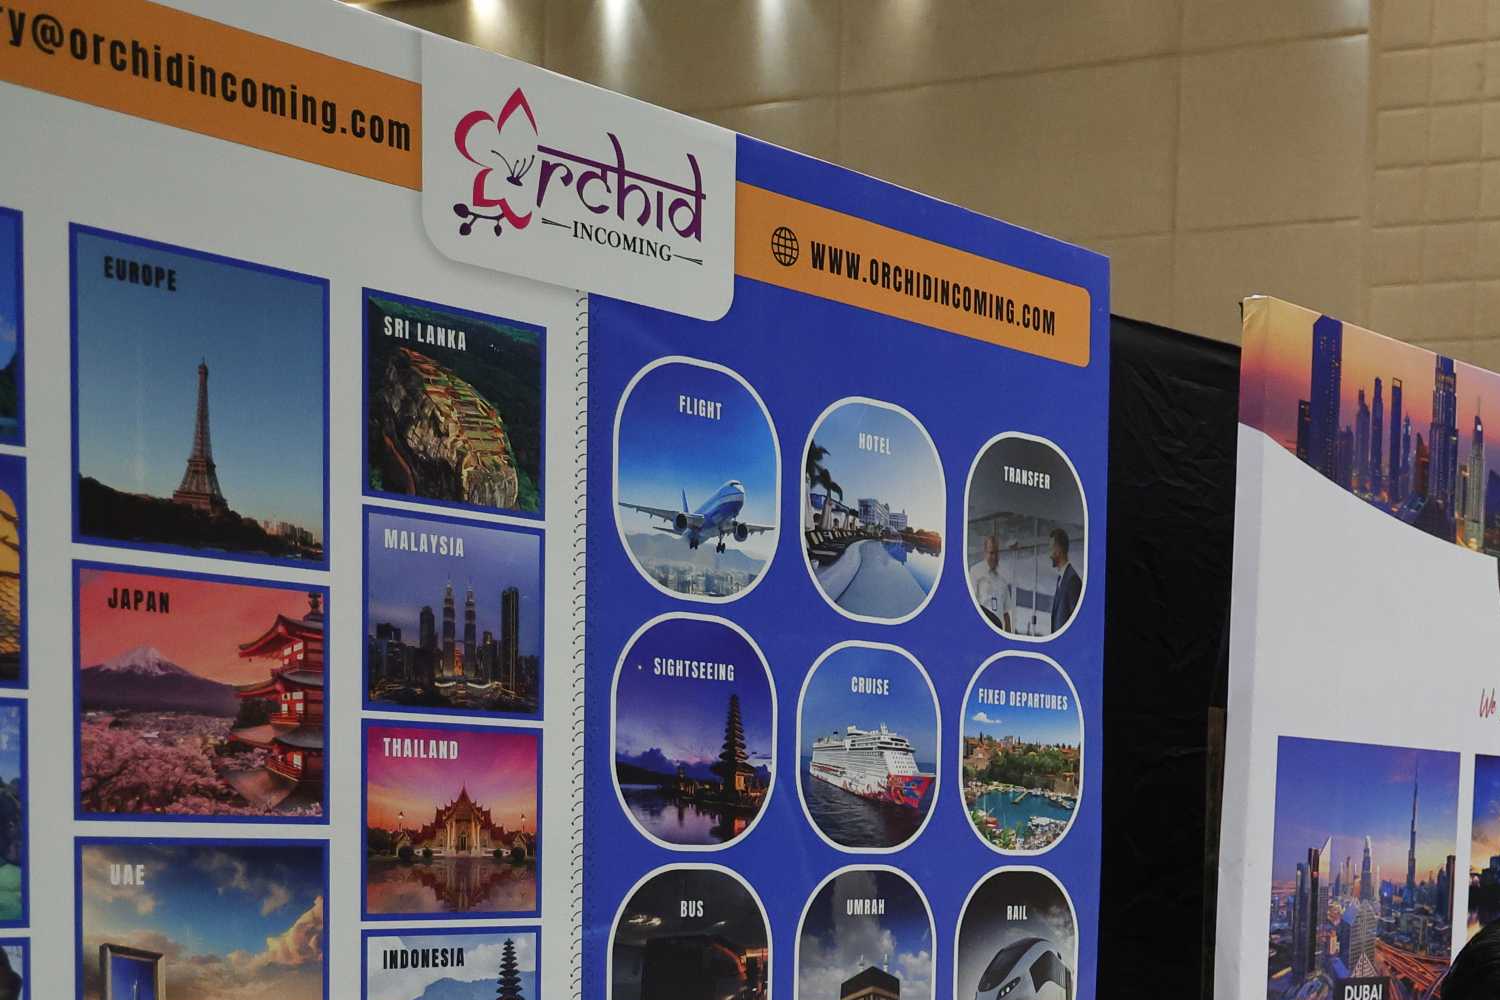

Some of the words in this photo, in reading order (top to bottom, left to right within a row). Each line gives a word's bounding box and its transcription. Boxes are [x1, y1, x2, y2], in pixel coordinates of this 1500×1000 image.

[572, 220, 673, 262] INCOMING
[103, 255, 178, 292] EUROPE
[811, 240, 1056, 337] WWW.ORCHIDINCOMING.COM
[383, 315, 411, 340] SRI
[416, 323, 468, 352] LANKA
[679, 394, 723, 421] FLIGHT
[858, 431, 892, 456] HOTEL
[1003, 465, 1052, 490] TRANSFER
[384, 528, 465, 558] MALAYSIA
[107, 586, 170, 615] JAPAN
[653, 657, 736, 683] SIGHTSEEING
[850, 676, 890, 697] CRUISE
[978, 688, 1007, 706] FIXED
[1009, 690, 1069, 711] DEPARTURES
[1480, 688, 1496, 719] We
[383, 737, 459, 761] THAILAND
[110, 863, 146, 886] UAE
[679, 899, 705, 919] BUS
[846, 898, 886, 917] UMRAH
[1006, 904, 1029, 922] RAIL
[383, 946, 466, 971] INDONESIA
